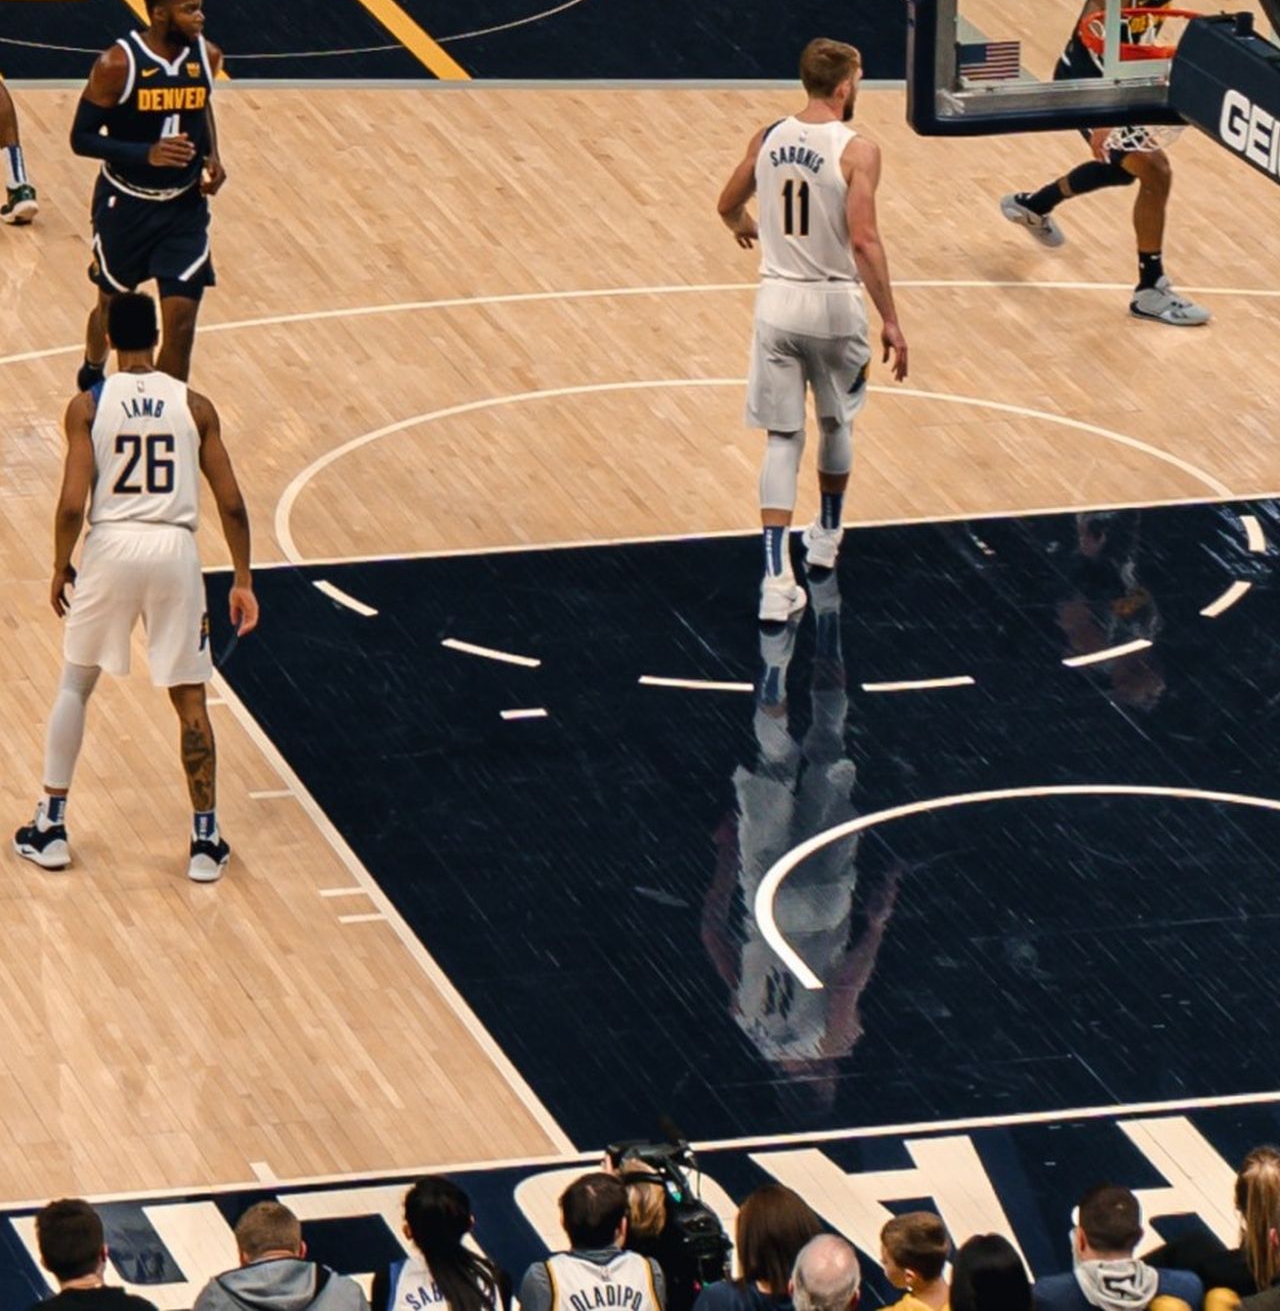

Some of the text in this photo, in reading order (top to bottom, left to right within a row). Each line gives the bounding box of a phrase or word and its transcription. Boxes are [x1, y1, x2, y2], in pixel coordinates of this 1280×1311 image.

[138, 87, 207, 111] DENVER
[770, 145, 825, 174] SABONIS
[782, 179, 809, 236] 11
[121, 398, 165, 419] LAMB
[113, 434, 175, 495] 26
[570, 1286, 643, 1311] OLADIPO
